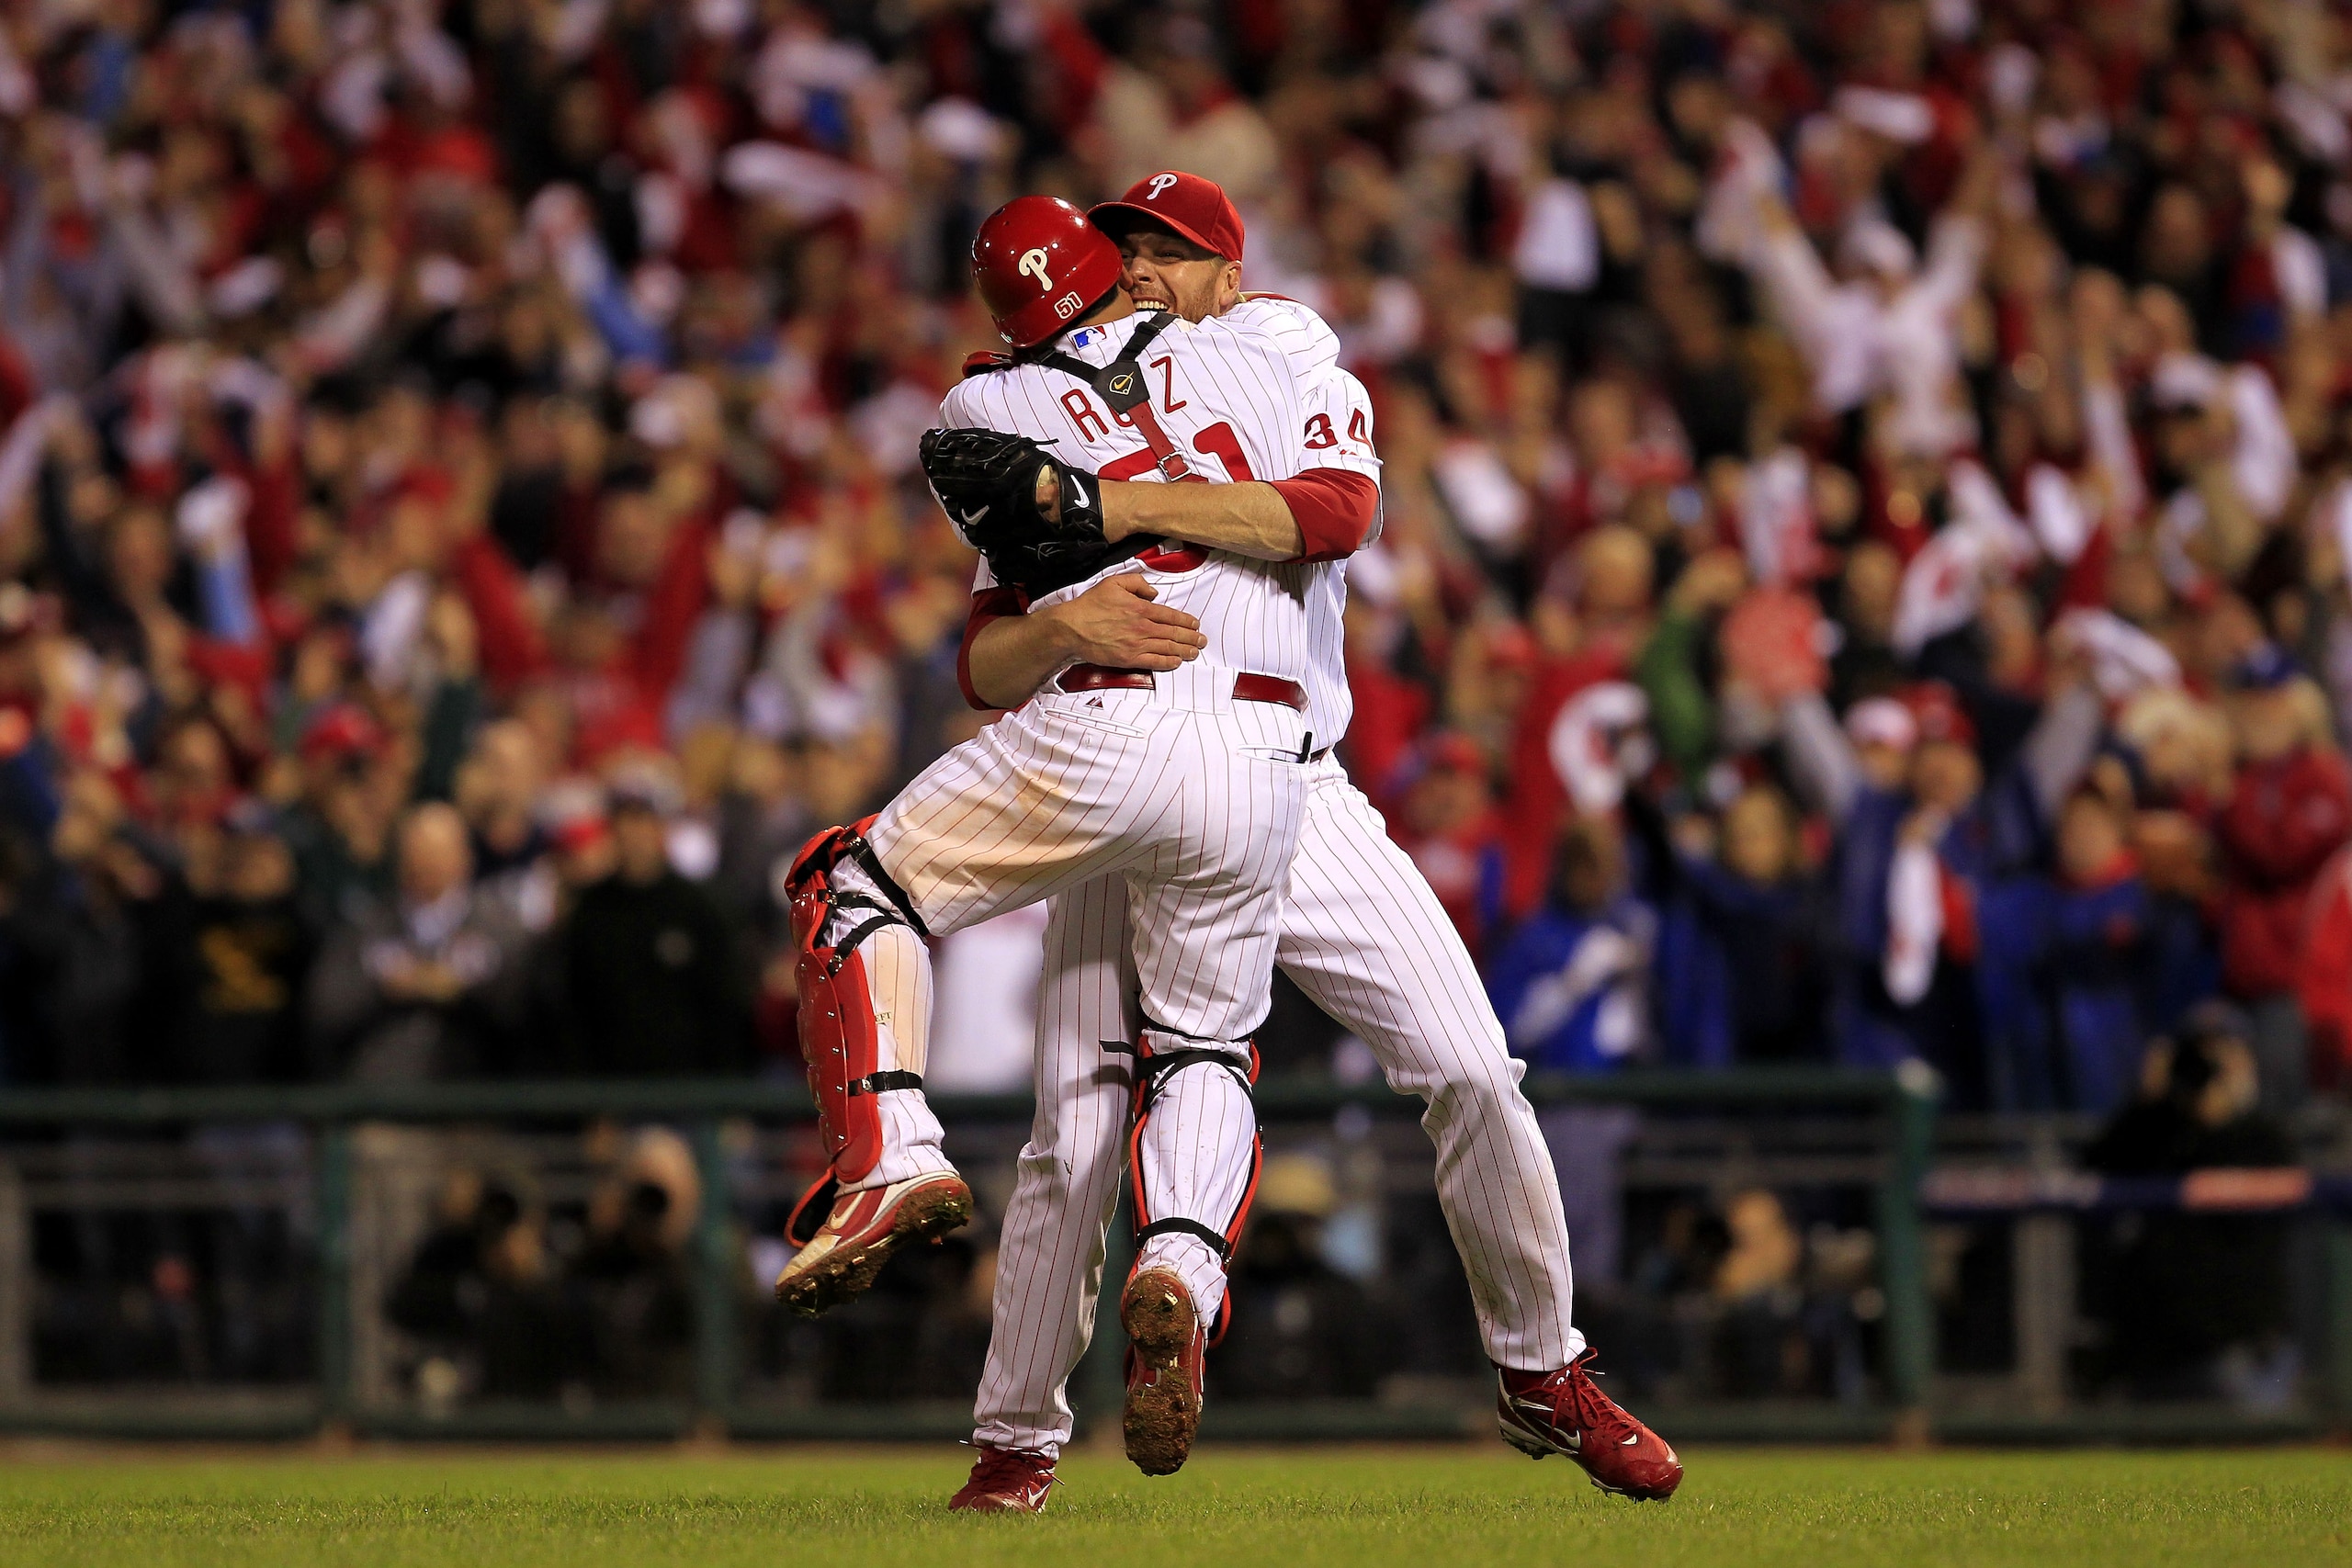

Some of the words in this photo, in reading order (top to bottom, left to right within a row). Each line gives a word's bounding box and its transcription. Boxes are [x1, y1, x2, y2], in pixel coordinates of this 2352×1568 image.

[1147, 173, 1177, 200] P
[1019, 248, 1053, 291] P
[1054, 291, 1083, 319] 51
[1060, 355, 1187, 443] RZ
[1304, 407, 1376, 458] 34
[874, 1011, 891, 1022] EFT
